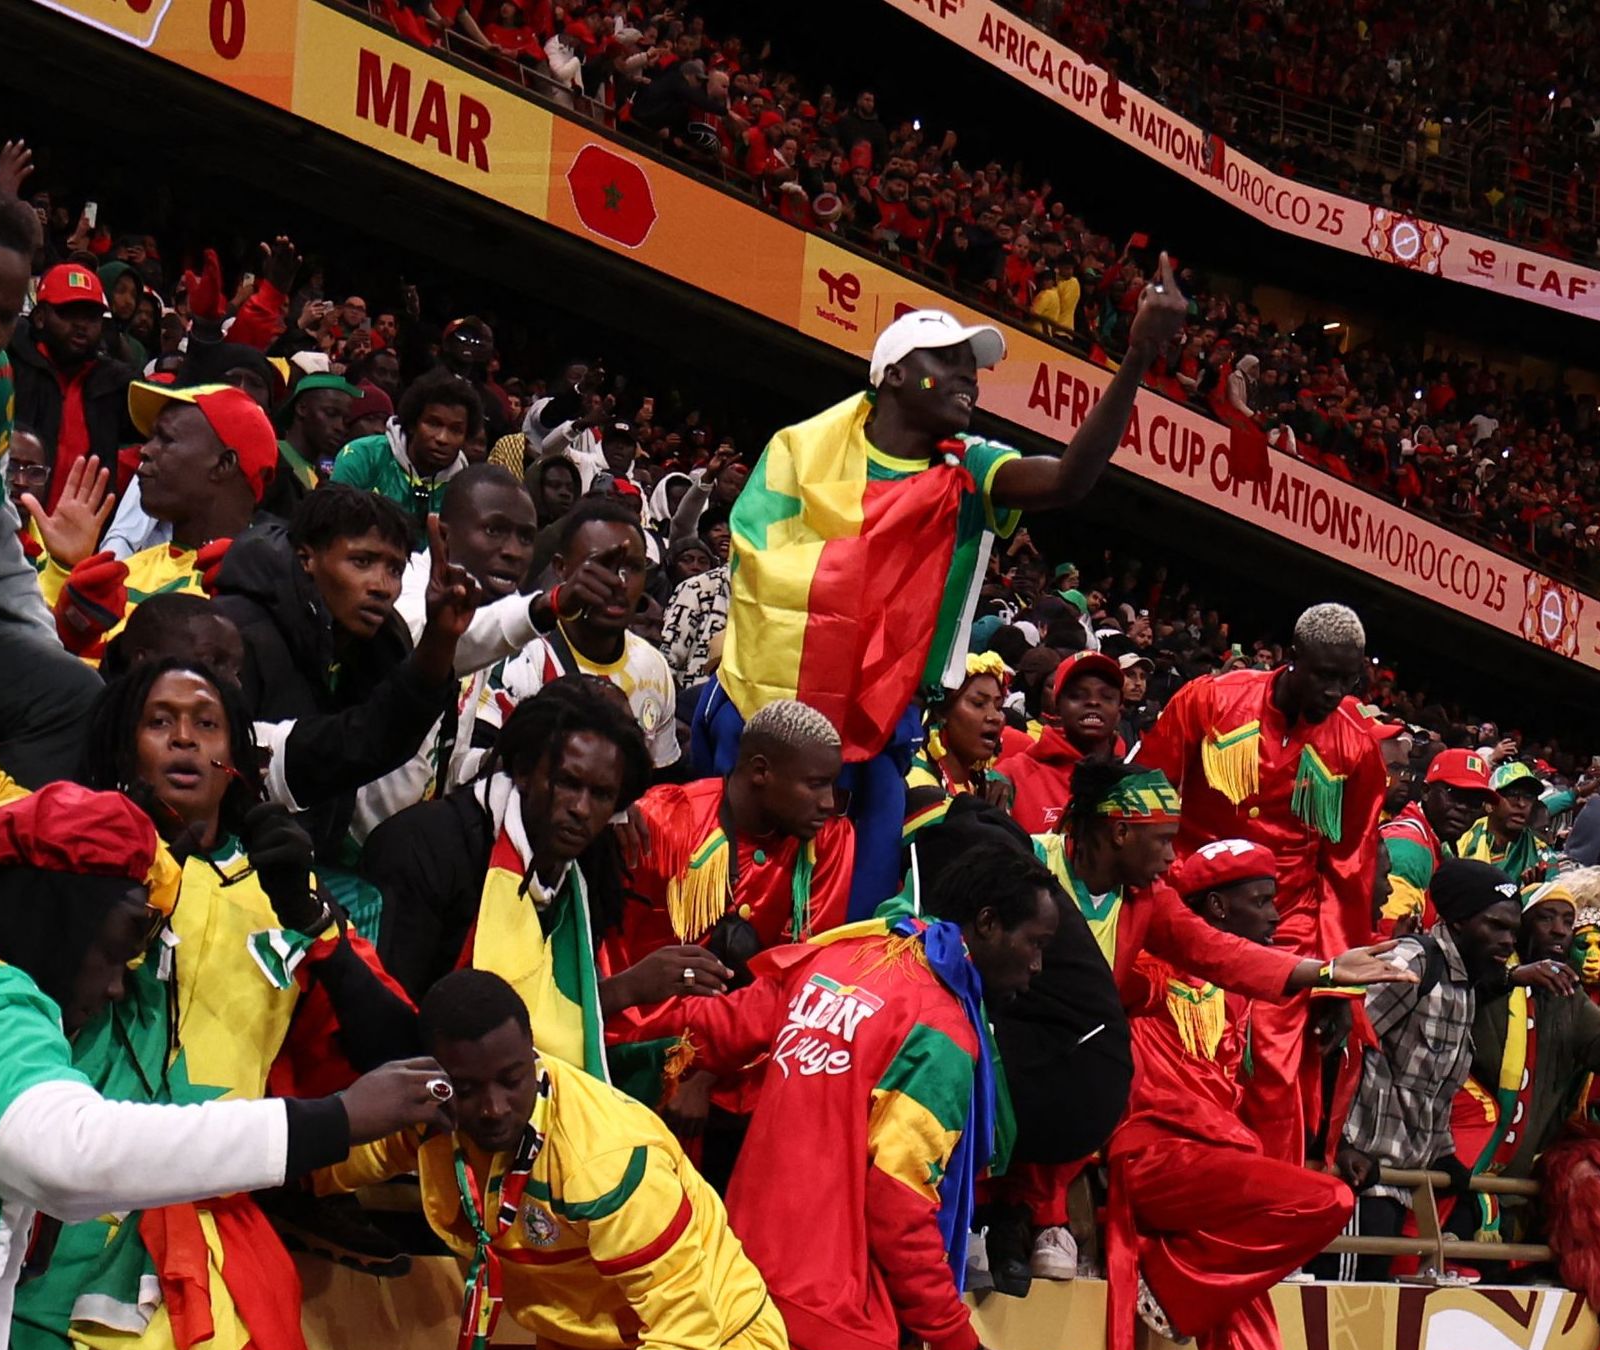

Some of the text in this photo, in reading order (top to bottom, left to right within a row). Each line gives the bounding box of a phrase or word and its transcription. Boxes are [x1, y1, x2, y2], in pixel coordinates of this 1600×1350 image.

[356, 48, 492, 173] MAR
[978, 12, 1054, 87] AFRICA
[1058, 60, 1098, 107] CUP
[1218, 163, 1311, 225] OROCCO
[1317, 202, 1345, 236] 25
[1516, 261, 1589, 301] CAF
[1027, 362, 1143, 456] AFRA
[1148, 414, 1206, 479] CUP
[1363, 513, 1480, 601] MOROCCO
[1483, 568, 1508, 612] 25
